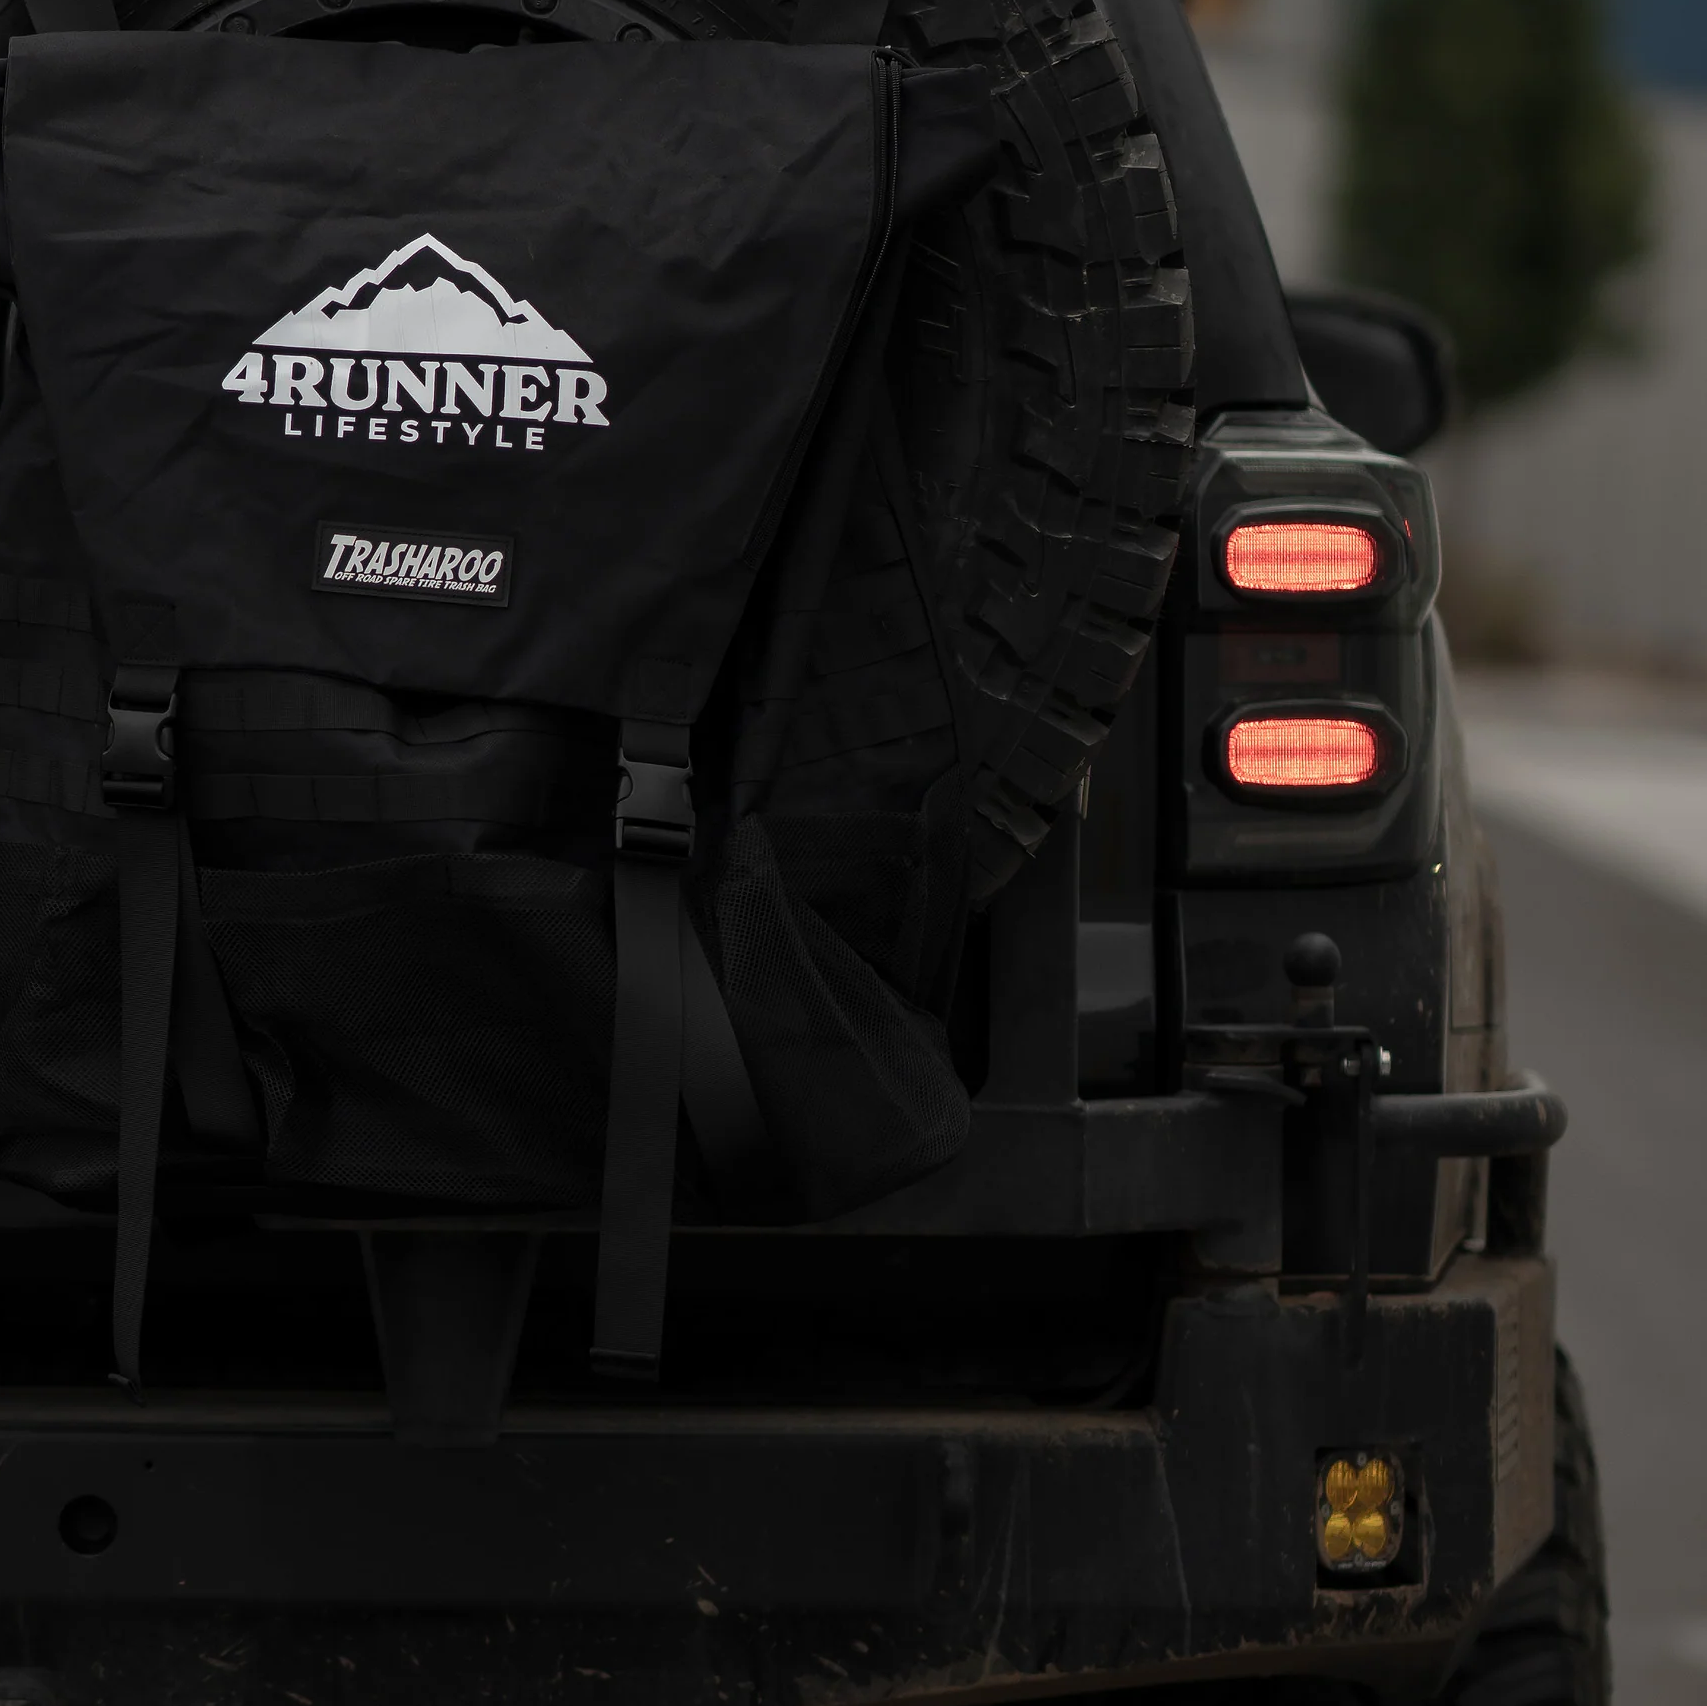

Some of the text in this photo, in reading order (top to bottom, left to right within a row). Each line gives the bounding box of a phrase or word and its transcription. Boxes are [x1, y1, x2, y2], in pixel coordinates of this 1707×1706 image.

[221, 352, 610, 427] 4RUNNER
[284, 413, 545, 451] LIFESTYLE
[335, 572, 497, 594] OFF ROAD SPARE TIRE TRASH BAG
